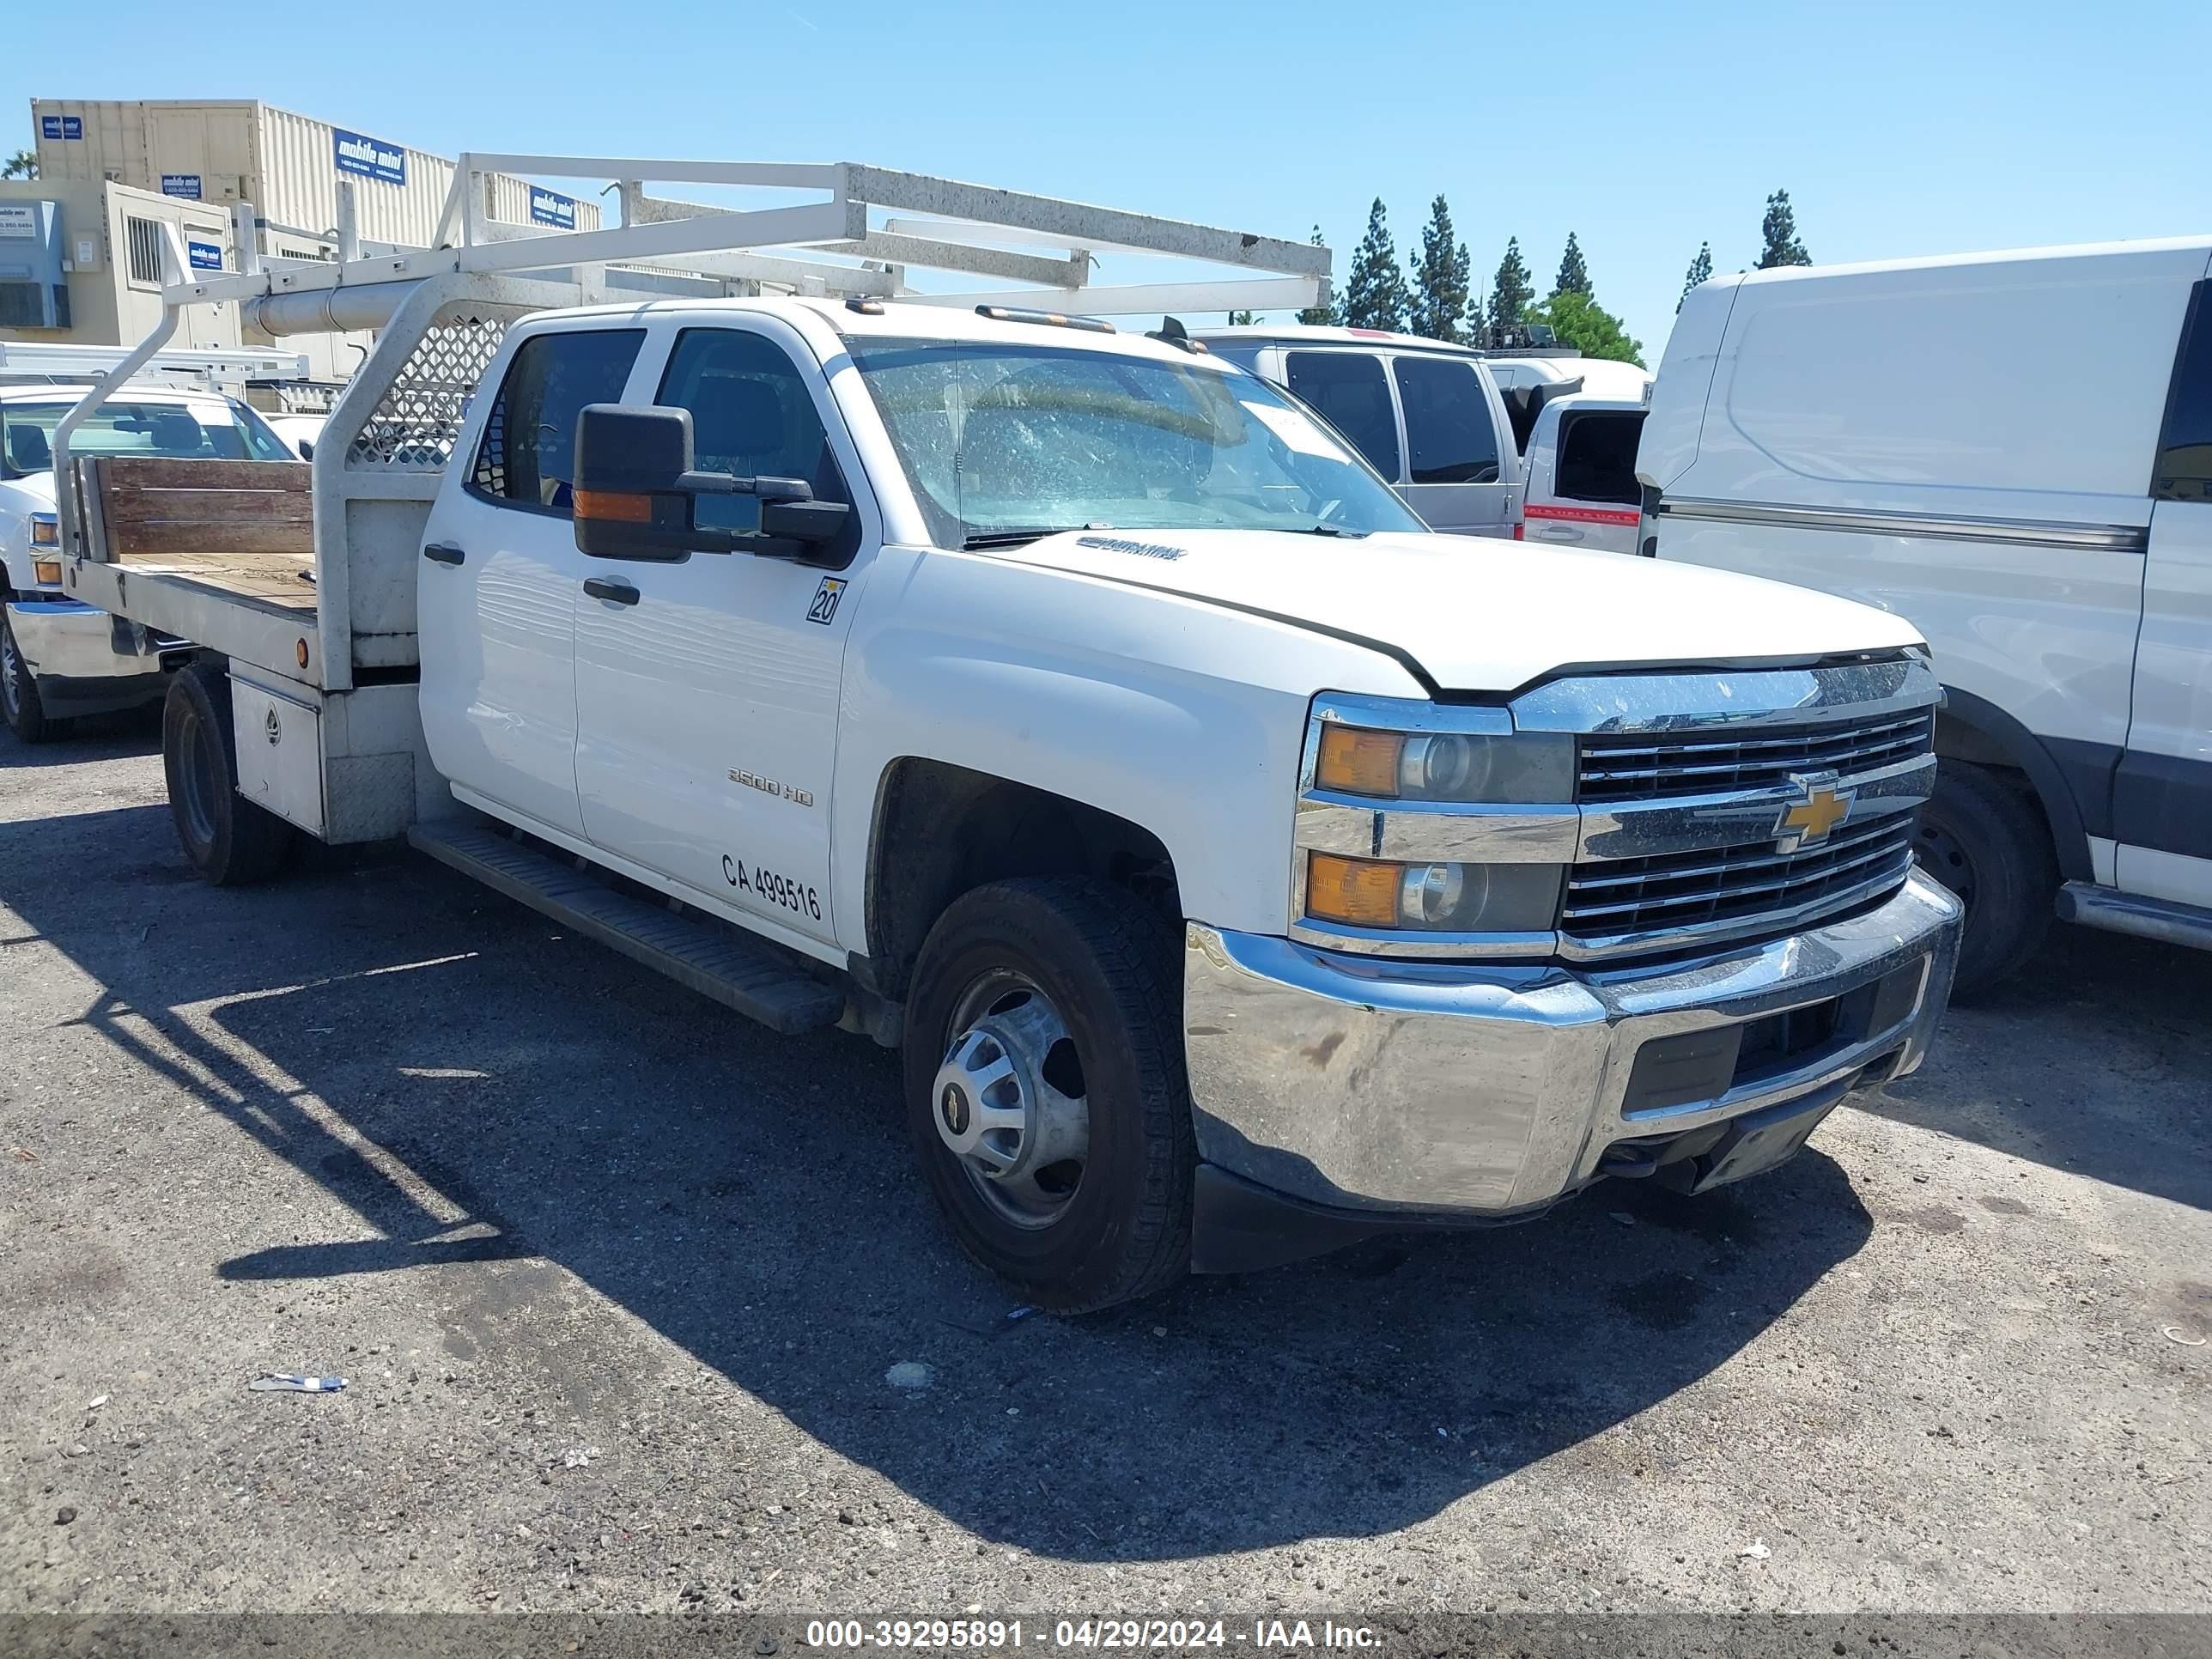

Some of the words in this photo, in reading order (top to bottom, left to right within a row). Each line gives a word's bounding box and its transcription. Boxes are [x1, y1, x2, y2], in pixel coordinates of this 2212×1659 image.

[337, 138, 377, 164] mobile
[377, 150, 404, 171] mini
[532, 193, 557, 214] mobile
[557, 201, 574, 218] mini
[810, 589, 837, 620] 20
[727, 766, 780, 796] 3500
[783, 783, 814, 807] HD
[722, 854, 753, 894] CA
[755, 866, 821, 921] 499516
